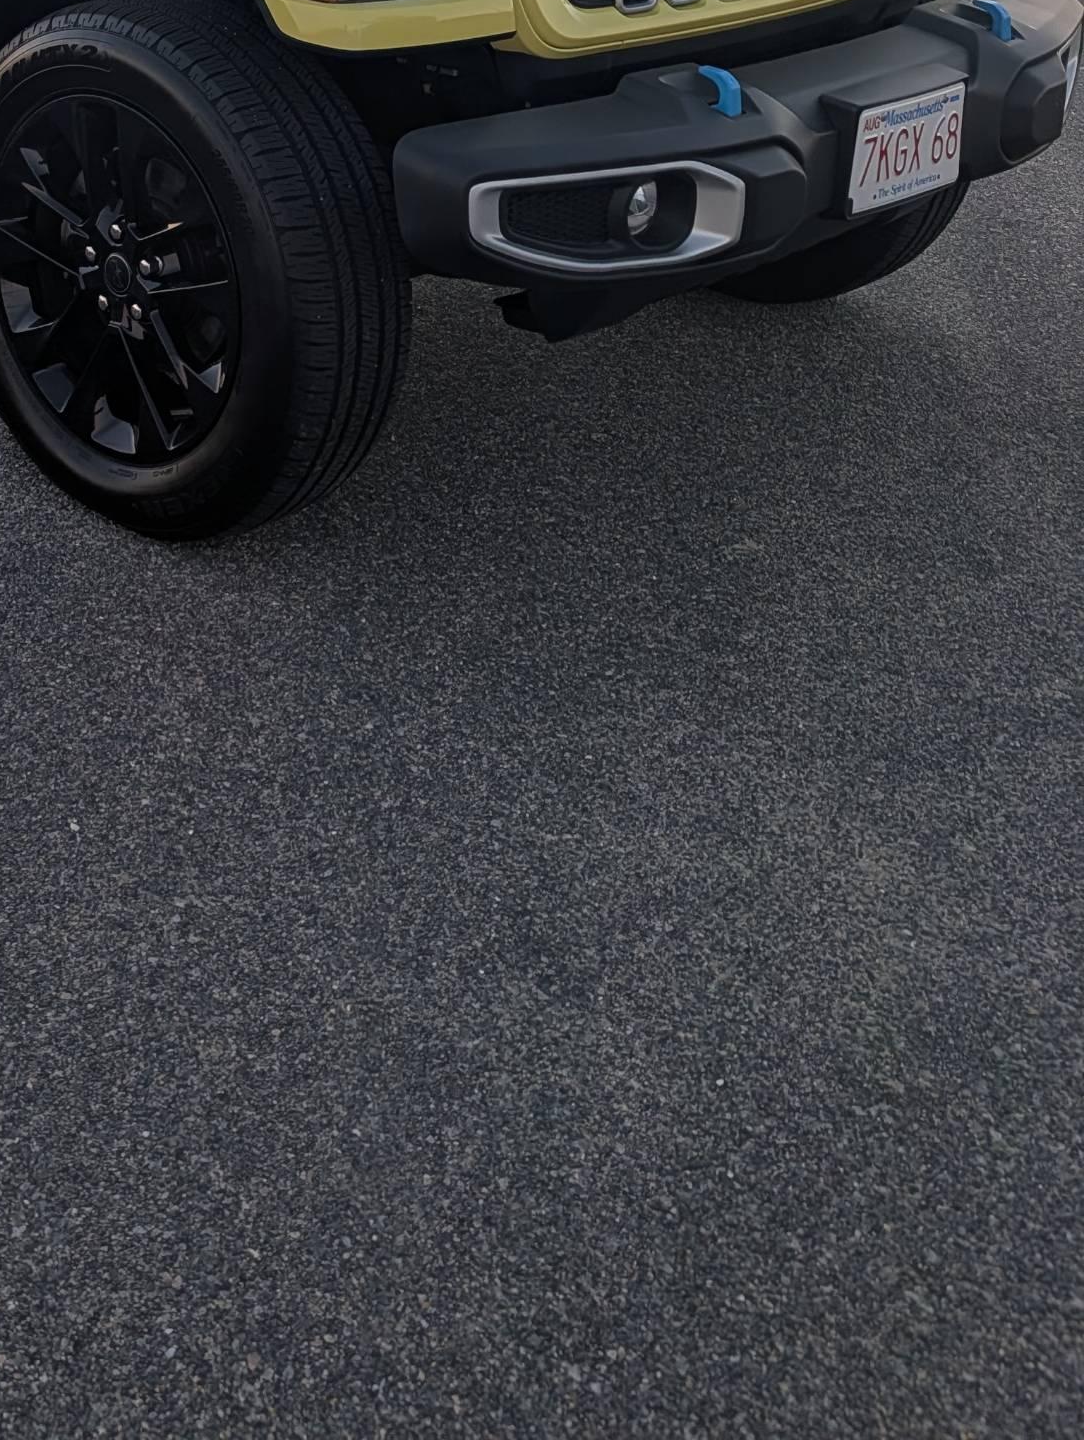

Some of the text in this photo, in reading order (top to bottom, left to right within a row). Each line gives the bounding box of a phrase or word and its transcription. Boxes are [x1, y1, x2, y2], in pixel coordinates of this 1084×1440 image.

[863, 99, 944, 132] AUG Massachusetts
[860, 112, 959, 187] 7KGX 68
[878, 188, 889, 198] The
[891, 183, 906, 195] Spirit
[915, 175, 936, 187] America
